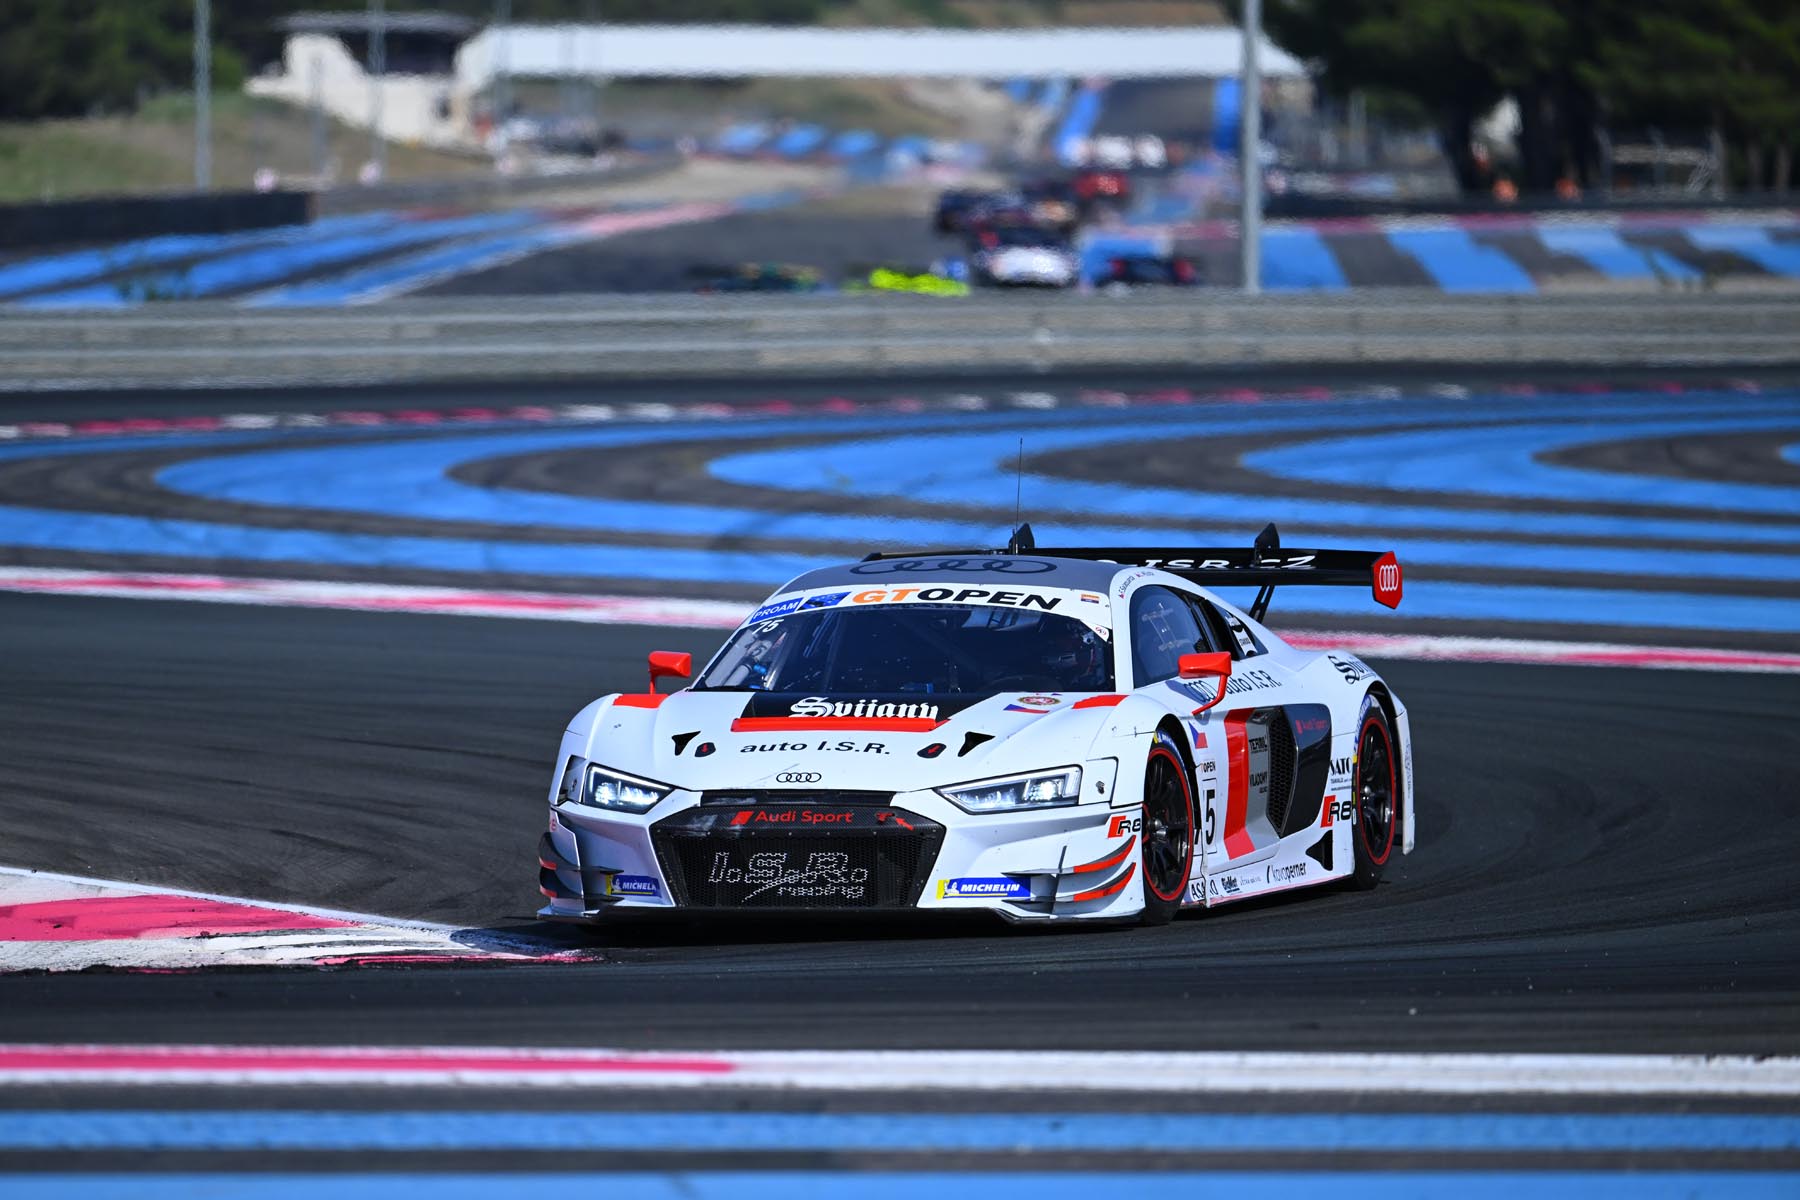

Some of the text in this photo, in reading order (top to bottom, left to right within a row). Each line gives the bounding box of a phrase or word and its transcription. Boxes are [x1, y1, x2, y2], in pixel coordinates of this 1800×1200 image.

[753, 601, 799, 619] PROAM
[751, 619, 785, 635] 75
[740, 740, 890, 755] auto I.S.R.
[755, 811, 854, 824] Audi Sport
[1328, 800, 1352, 822] R8
[1117, 817, 1142, 835] R8
[960, 883, 1020, 892] MICHELIN
